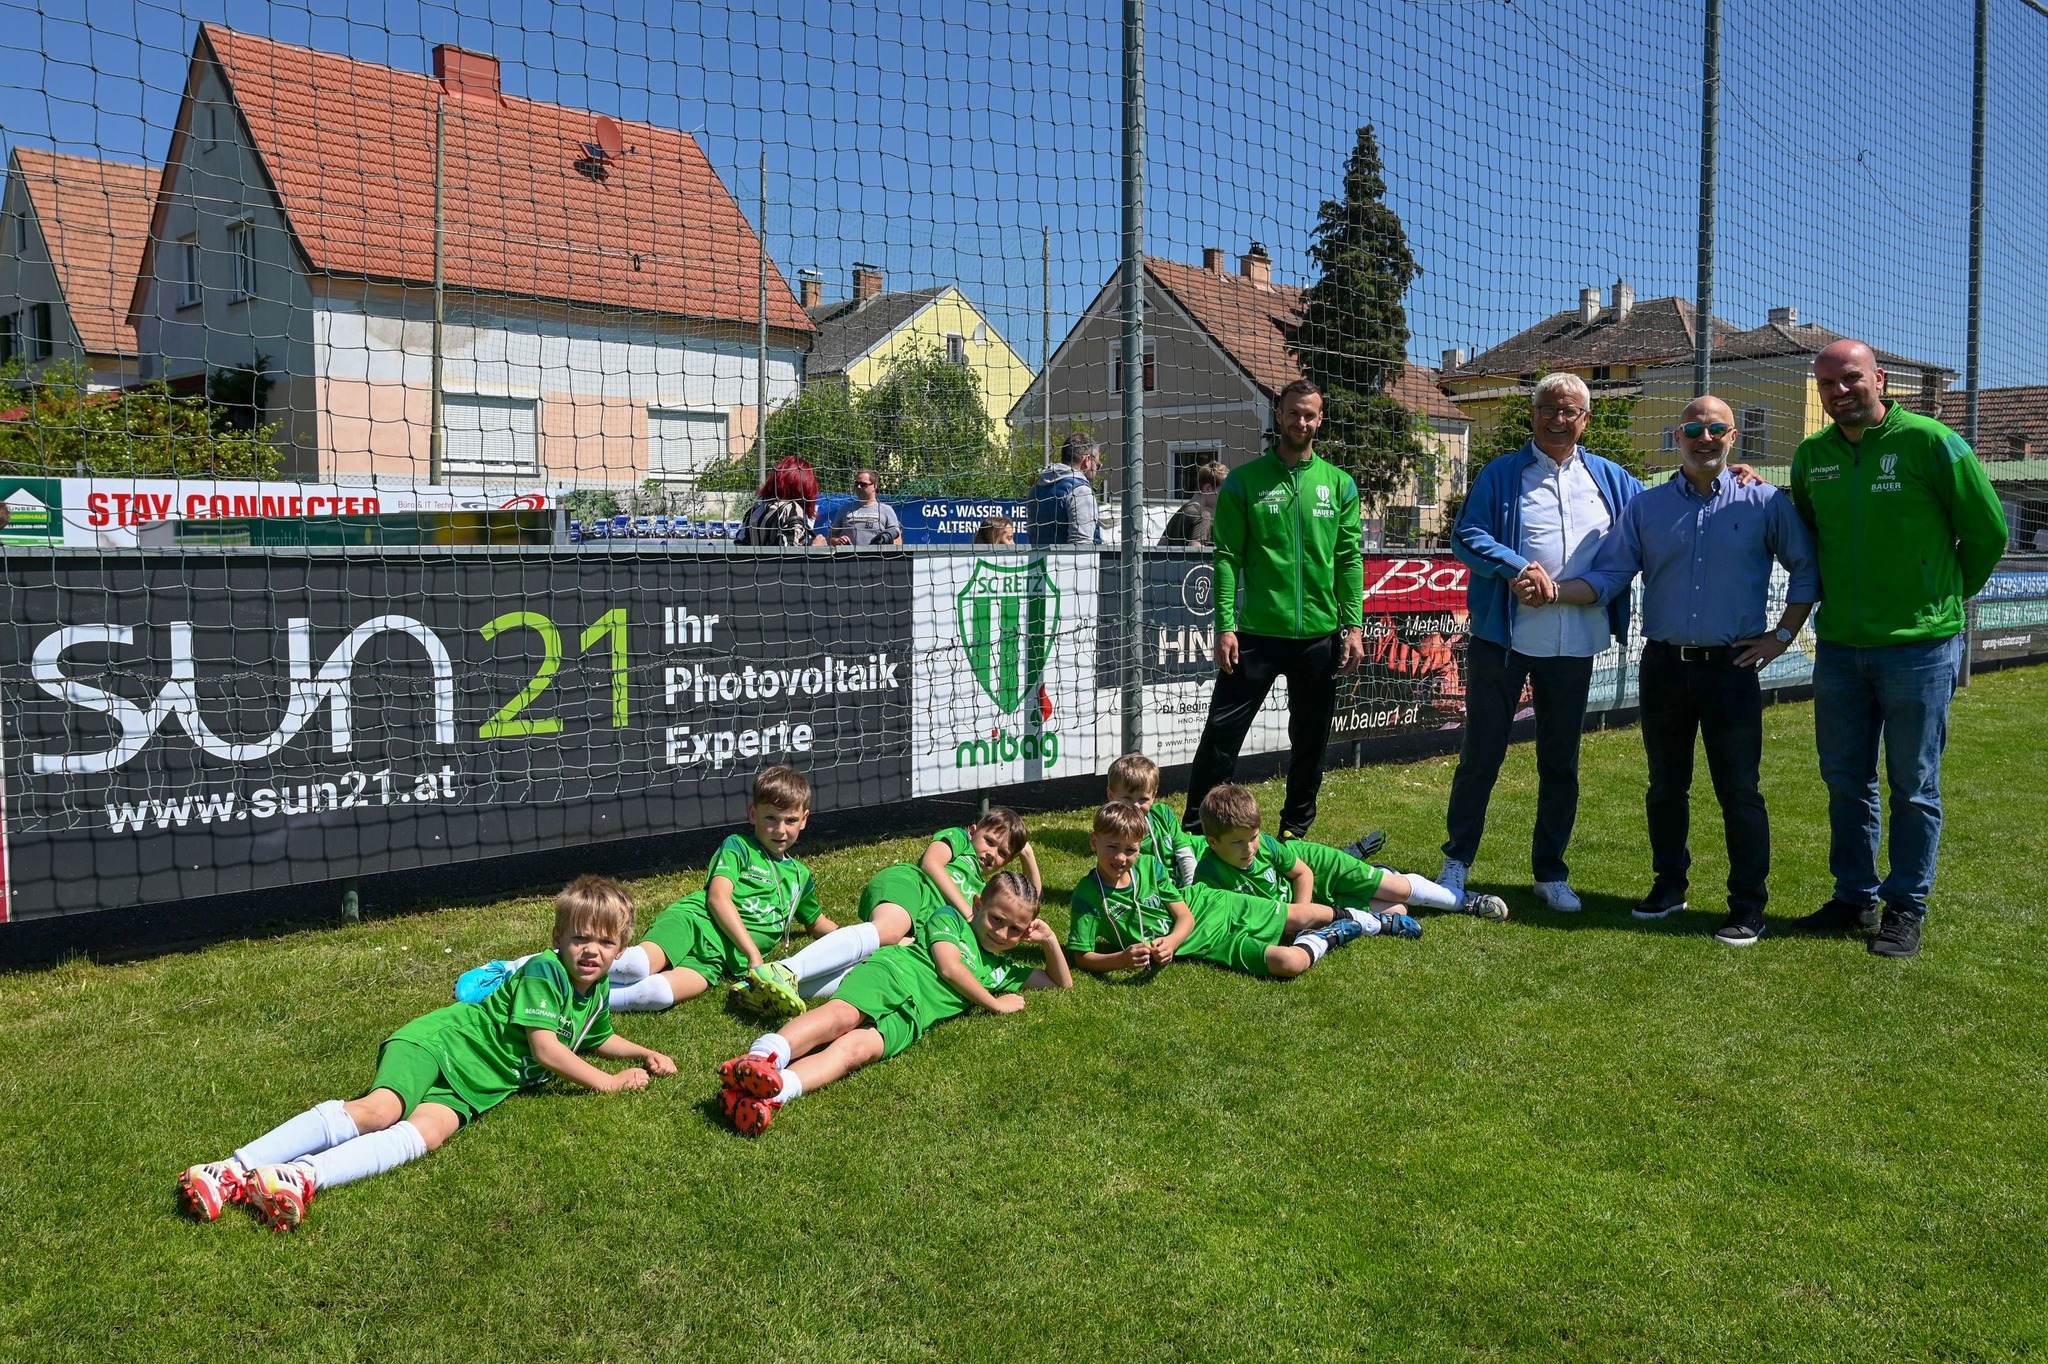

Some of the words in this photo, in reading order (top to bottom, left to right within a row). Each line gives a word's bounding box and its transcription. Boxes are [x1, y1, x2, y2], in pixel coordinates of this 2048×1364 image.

[1810, 464, 1839, 473] uhlsport
[1258, 489, 1286, 497] uhlsport
[1871, 482, 1901, 490] BAUER
[88, 493, 172, 526] STAY
[397, 500, 416, 508] Büro
[433, 501, 458, 509] Technik
[922, 505, 947, 517] GAS
[956, 505, 1003, 518] WASSER
[1268, 504, 1279, 514] TR
[1312, 508, 1335, 516] BAUER
[977, 576, 998, 594] SC
[1002, 576, 1044, 594] RETZ
[1362, 559, 1468, 600] Ba
[665, 606, 719, 645] Ihr
[1405, 614, 1470, 637] Metallbau
[1158, 624, 1215, 665] HN
[665, 653, 899, 705] Photovoltaik
[1162, 705, 1177, 714] Dr.
[1331, 704, 1420, 732] w.bauer1.at
[665, 720, 814, 770] Experte
[956, 728, 1059, 769] mibag
[104, 765, 456, 834] www.sun21.at
[524, 1008, 557, 1019] BERGMANN
